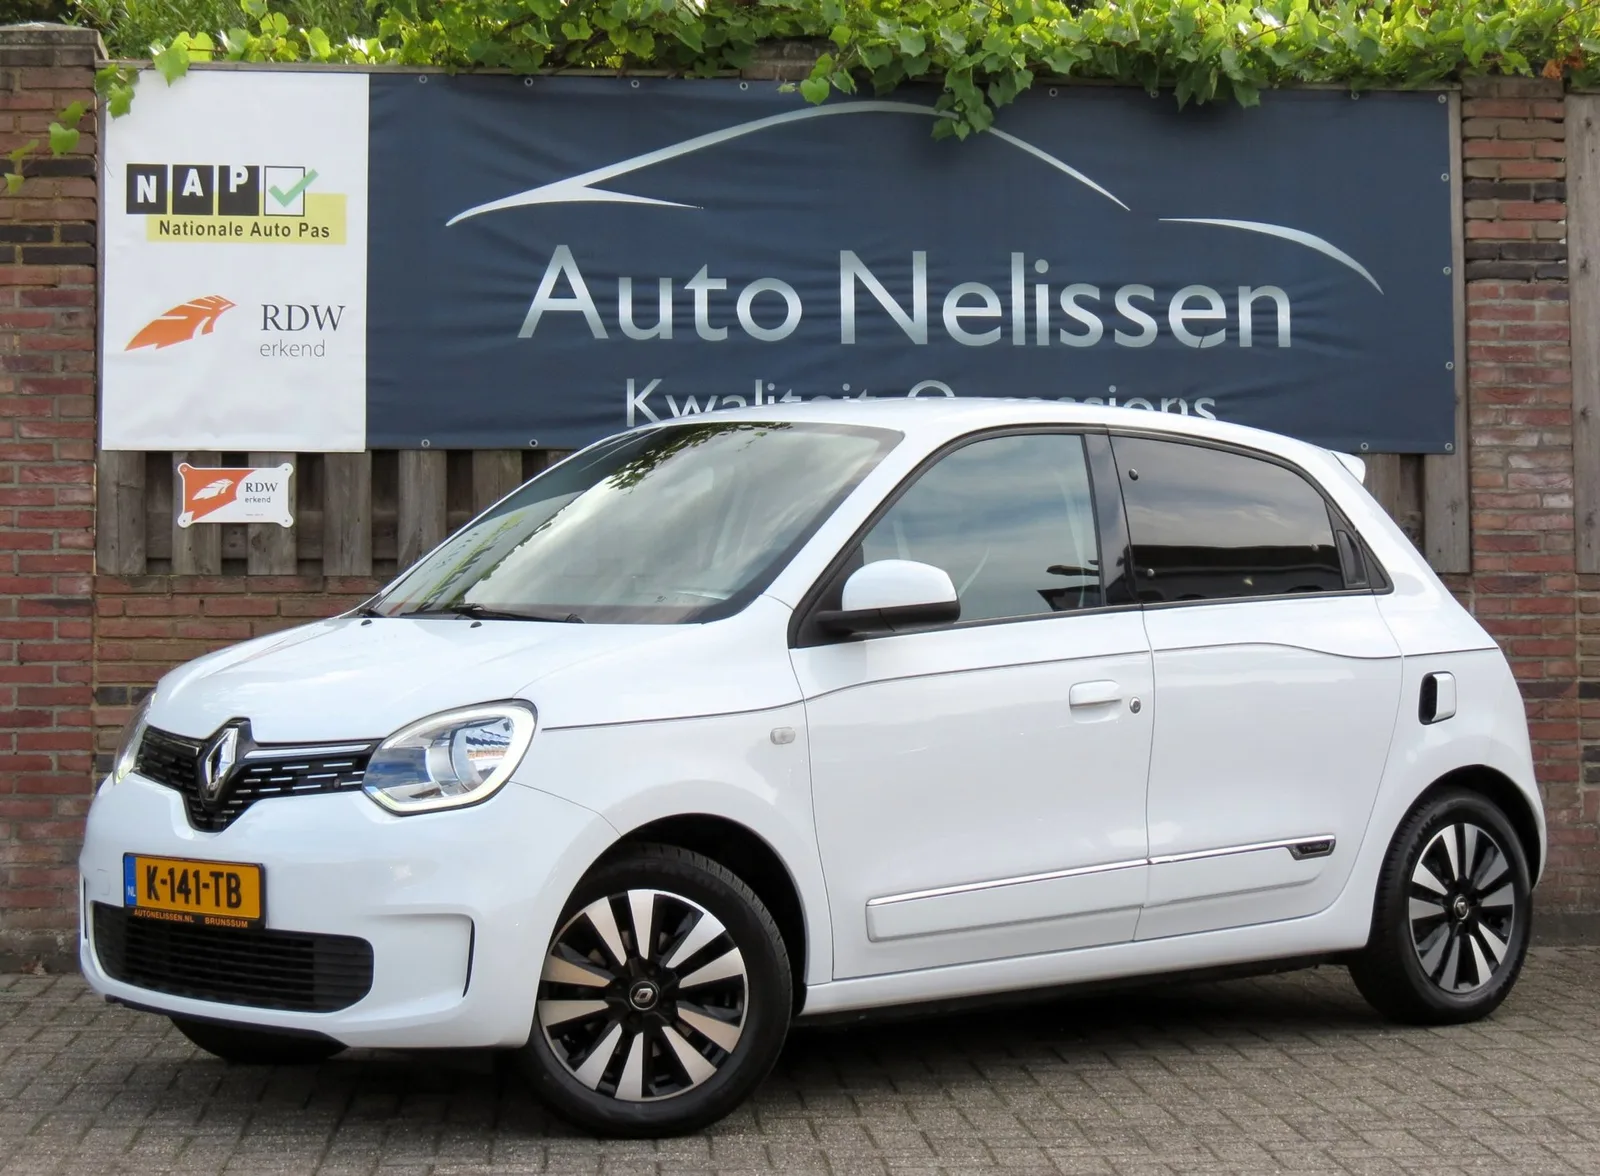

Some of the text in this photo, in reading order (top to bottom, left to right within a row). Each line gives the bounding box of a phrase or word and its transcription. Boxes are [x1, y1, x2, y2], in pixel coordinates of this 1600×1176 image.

[136, 165, 249, 204] NAP
[159, 220, 331, 239] Nationale Auto Pas
[517, 244, 1292, 349] Auto Nelissen
[260, 303, 346, 332] RDW
[259, 339, 326, 358] erkend
[245, 481, 279, 493] RDW
[244, 495, 272, 504] erkend
[127, 885, 137, 898] NL
[146, 864, 242, 909] K-141-TB
[133, 909, 249, 929] AUTONELISSEN.NL BRUNSSUM
